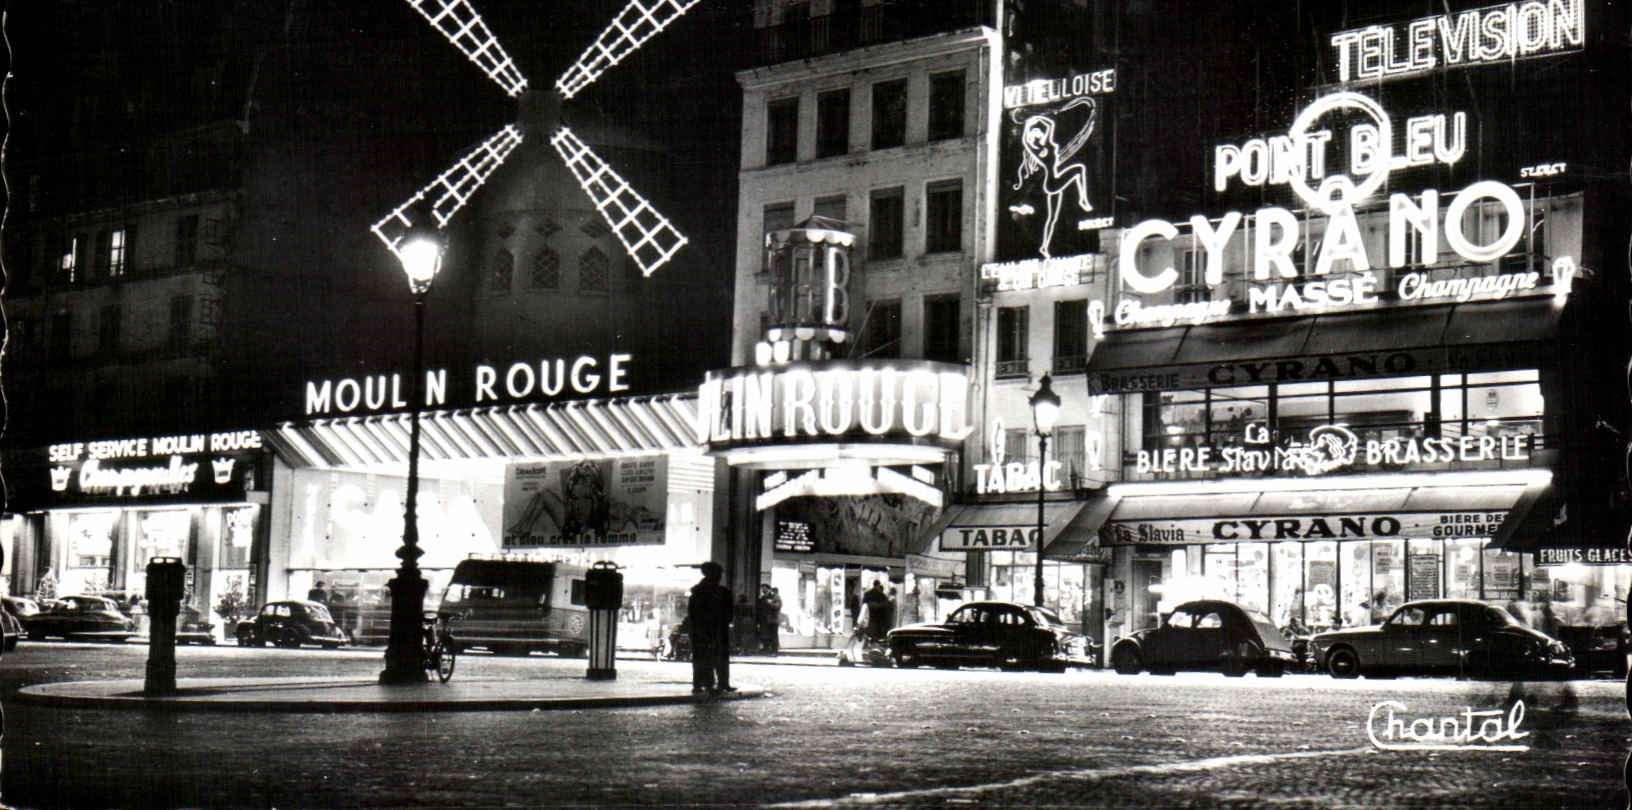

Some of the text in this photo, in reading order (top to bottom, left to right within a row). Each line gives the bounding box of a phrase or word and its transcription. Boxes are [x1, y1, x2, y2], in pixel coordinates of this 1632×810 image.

[1119, 178, 1526, 294] CYRANO
[1248, 270, 1379, 314] MASSÉ
[1398, 271, 1540, 302] Champagne
[305, 354, 632, 415] MOULN ROUGE
[1100, 372, 1180, 391] BRASSERIE
[1207, 352, 1417, 386] CYRANO
[783, 366, 974, 441] ROUGE
[49, 430, 262, 462] SELF SERVICE MOULIN ROUGE
[1244, 423, 1270, 443] La
[1366, 435, 1529, 465] BRASSERIE
[972, 460, 1062, 495] TABAC
[1137, 523, 1185, 543] Slavia
[1212, 515, 1402, 541] CYRANO
[1540, 548, 1583, 563] FRUITS
